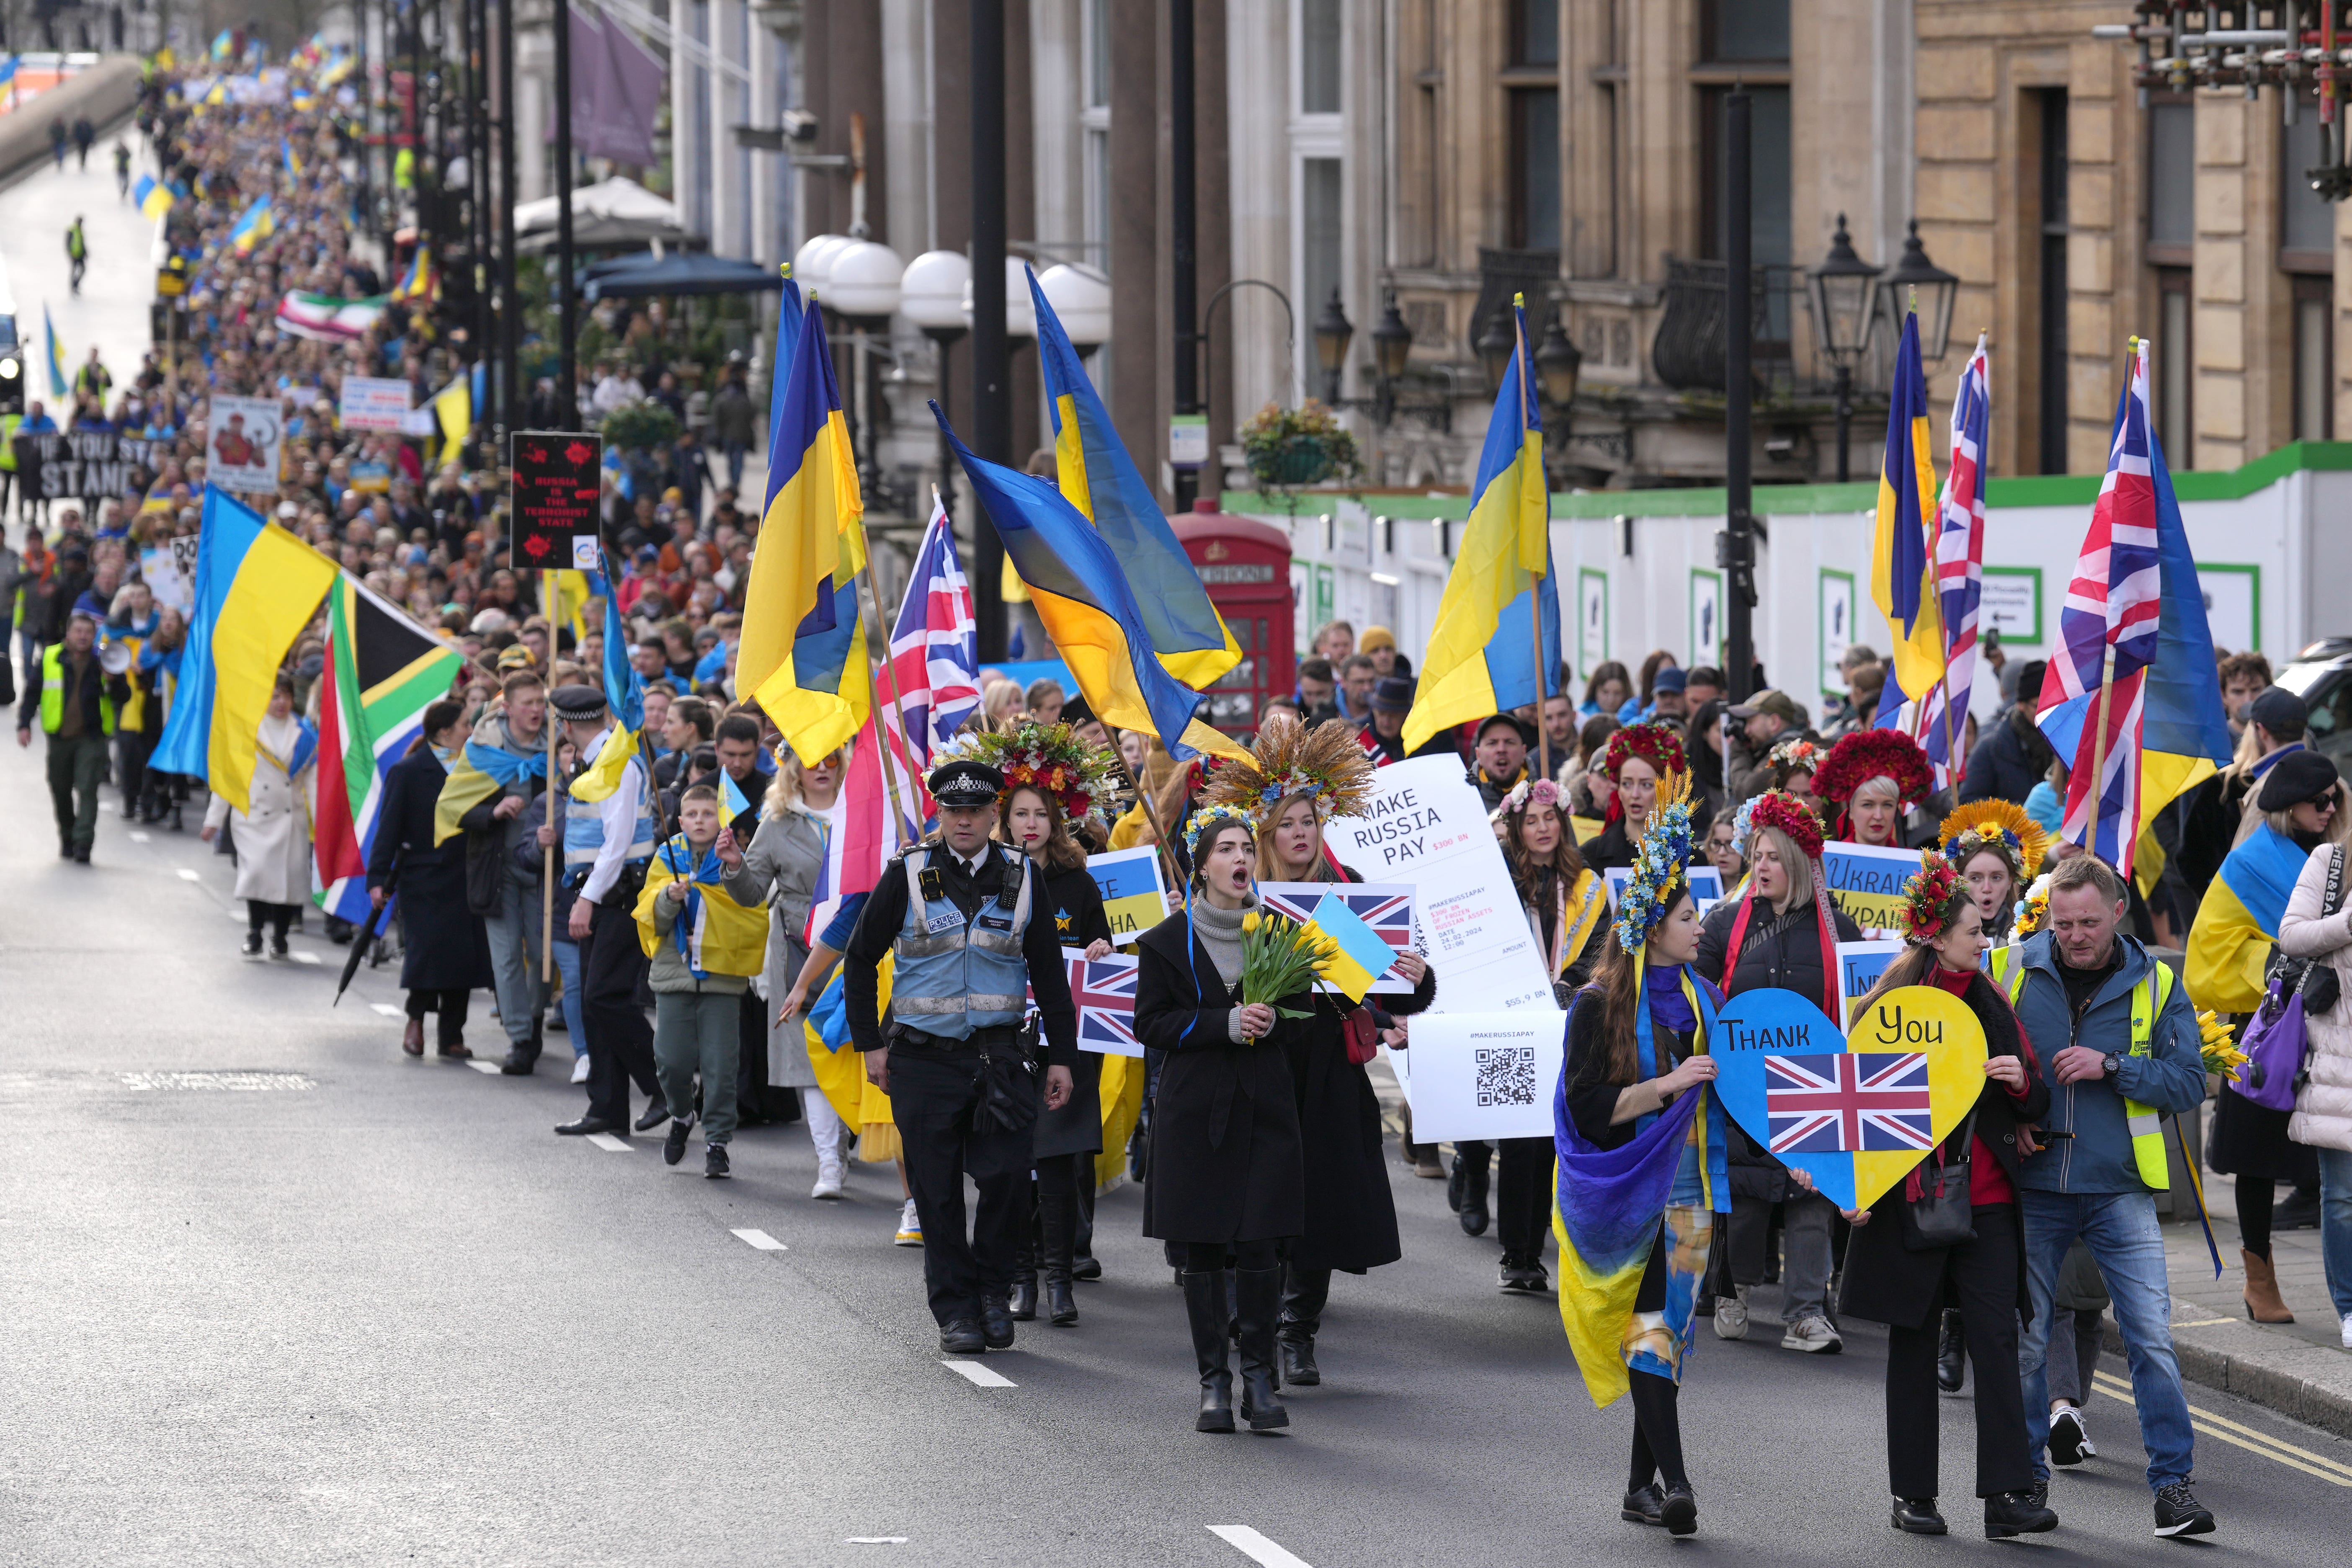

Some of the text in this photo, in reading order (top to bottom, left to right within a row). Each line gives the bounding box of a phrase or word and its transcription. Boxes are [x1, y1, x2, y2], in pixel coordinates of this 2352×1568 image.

[535, 477, 578, 487] RUSSIA
[550, 487, 562, 496] IS
[544, 497, 567, 506] THE
[524, 507, 588, 517] TERRORIST
[538, 517, 575, 527] STATE
[1361, 788, 1418, 822] MAKE
[1354, 807, 1442, 848] RUSSIA
[1383, 833, 1469, 865] PAY $300 BN
[1428, 886, 1485, 910] #MAKERUSSIAPAY
[1431, 908, 1448, 918] $300
[1435, 907, 1493, 931] RUSSIAN ASSETS
[1445, 908, 1470, 920] FROZEN
[929, 913, 961, 928] POLICE
[1438, 928, 1455, 938] DATE
[1441, 926, 1482, 944] 24.02.2024
[1443, 940, 1465, 951] 12:00
[1502, 941, 1527, 954] AMOUNT
[1505, 989, 1546, 1008] $55,9 BN
[1718, 1019, 1810, 1051] THANK
